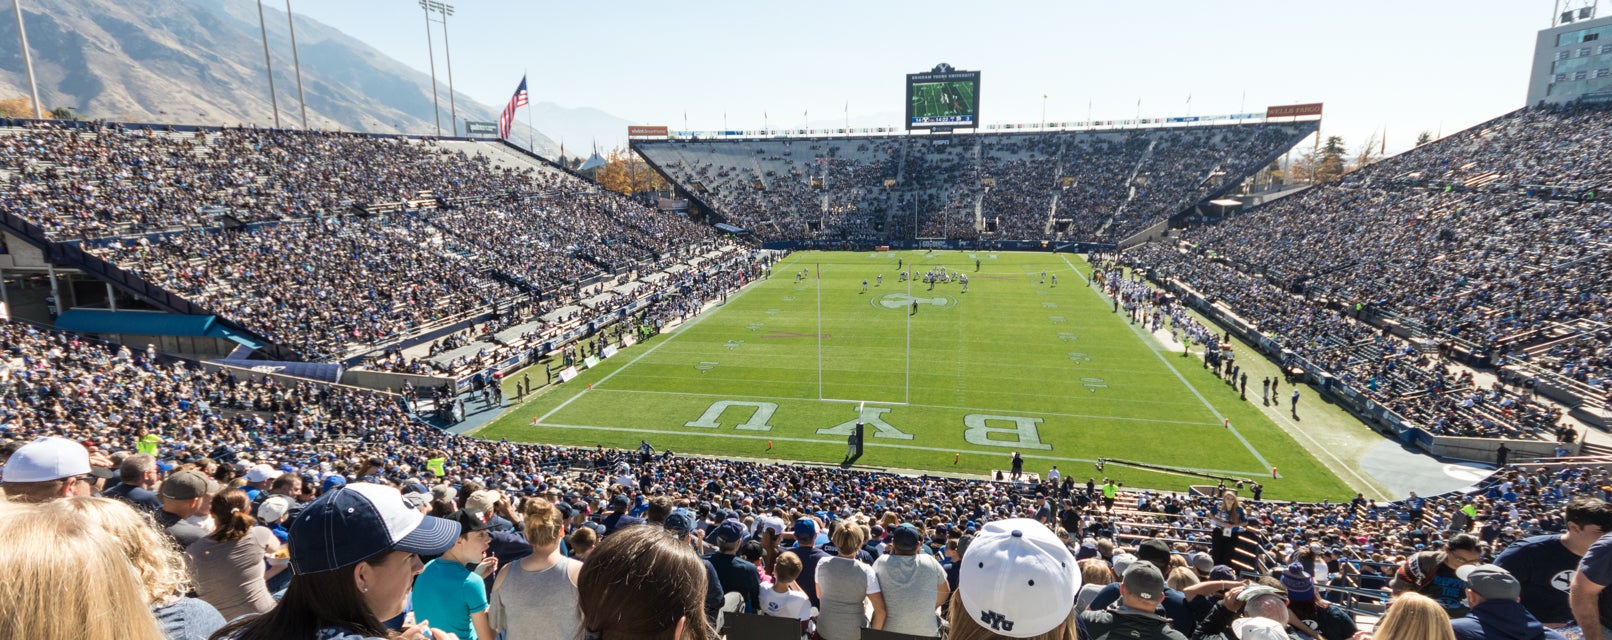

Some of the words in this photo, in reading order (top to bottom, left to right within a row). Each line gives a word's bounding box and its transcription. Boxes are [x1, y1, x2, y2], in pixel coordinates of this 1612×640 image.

[1268, 107, 1294, 115] WELLS
[1296, 105, 1321, 113] FARGO
[981, 609, 1014, 631] BYU
